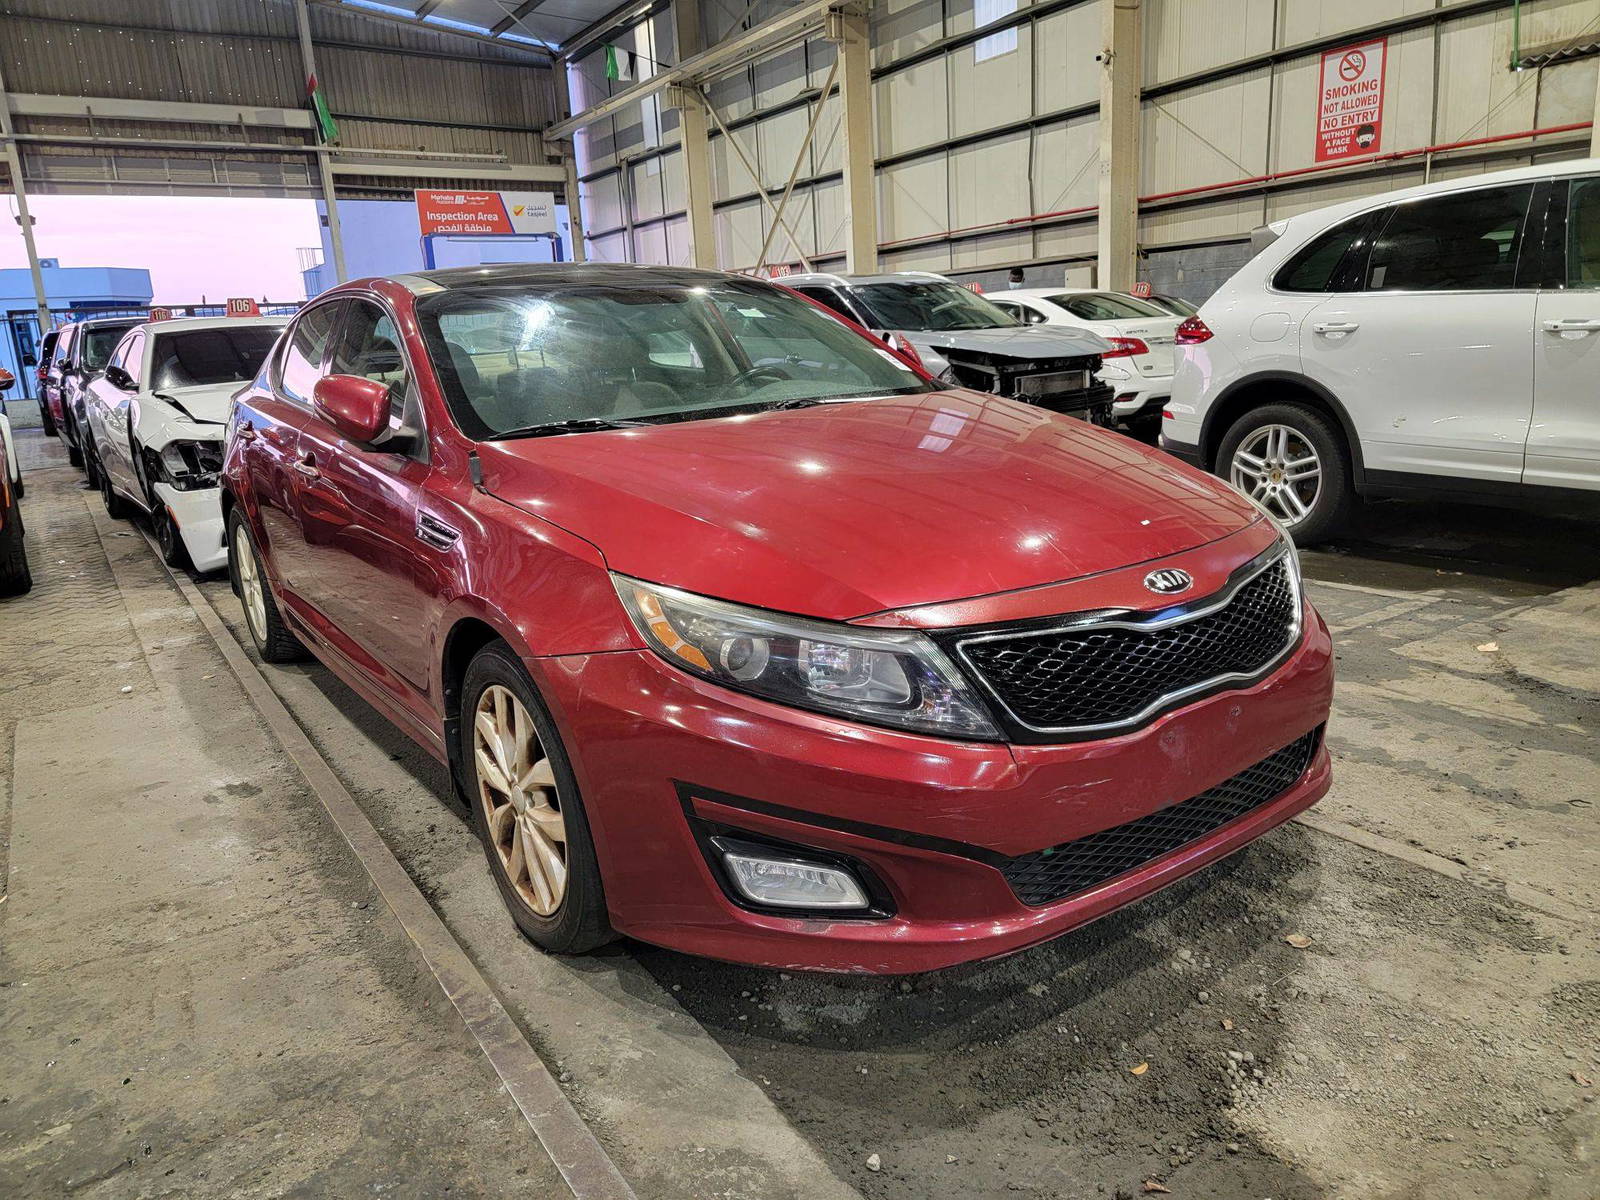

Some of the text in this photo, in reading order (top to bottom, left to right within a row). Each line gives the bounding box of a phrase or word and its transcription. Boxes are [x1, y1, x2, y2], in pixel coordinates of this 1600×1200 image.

[1325, 79, 1378, 100] SMOKING
[1323, 94, 1378, 115] NOT ALLOWED
[1323, 110, 1377, 130] NO ENTRY
[1321, 128, 1356, 140] WITHOUT
[1332, 137, 1351, 147] FACE
[1326, 146, 1348, 155] MASK
[426, 211, 499, 222] Inspection Area
[231, 299, 250, 312] 106
[154, 311, 167, 320] 116
[1145, 570, 1190, 590] KIA
